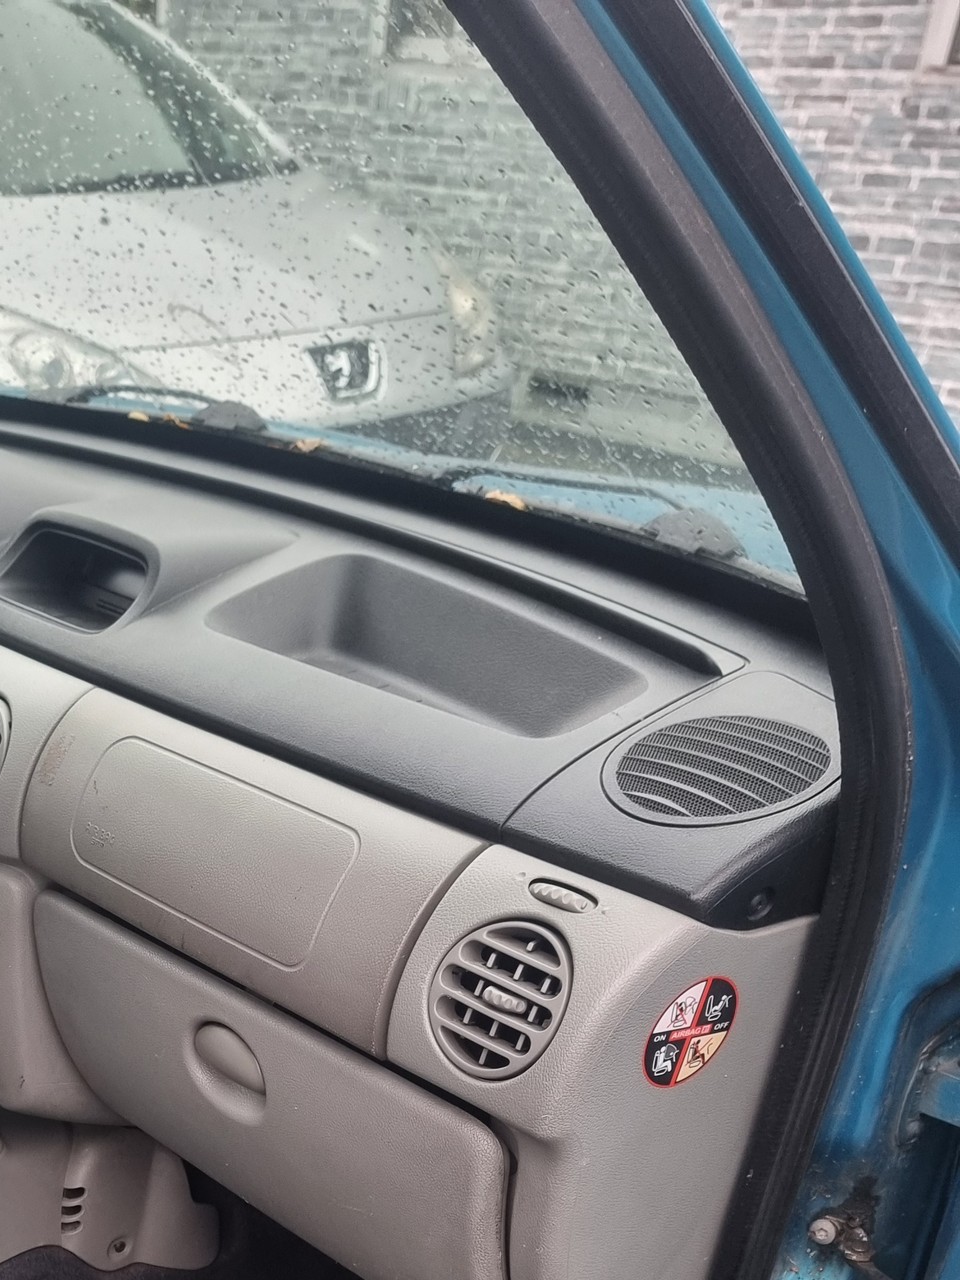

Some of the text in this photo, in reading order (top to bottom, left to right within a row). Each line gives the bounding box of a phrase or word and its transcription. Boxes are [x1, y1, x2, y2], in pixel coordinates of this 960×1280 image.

[653, 1021, 730, 1042] ON AIRBAG OFF
